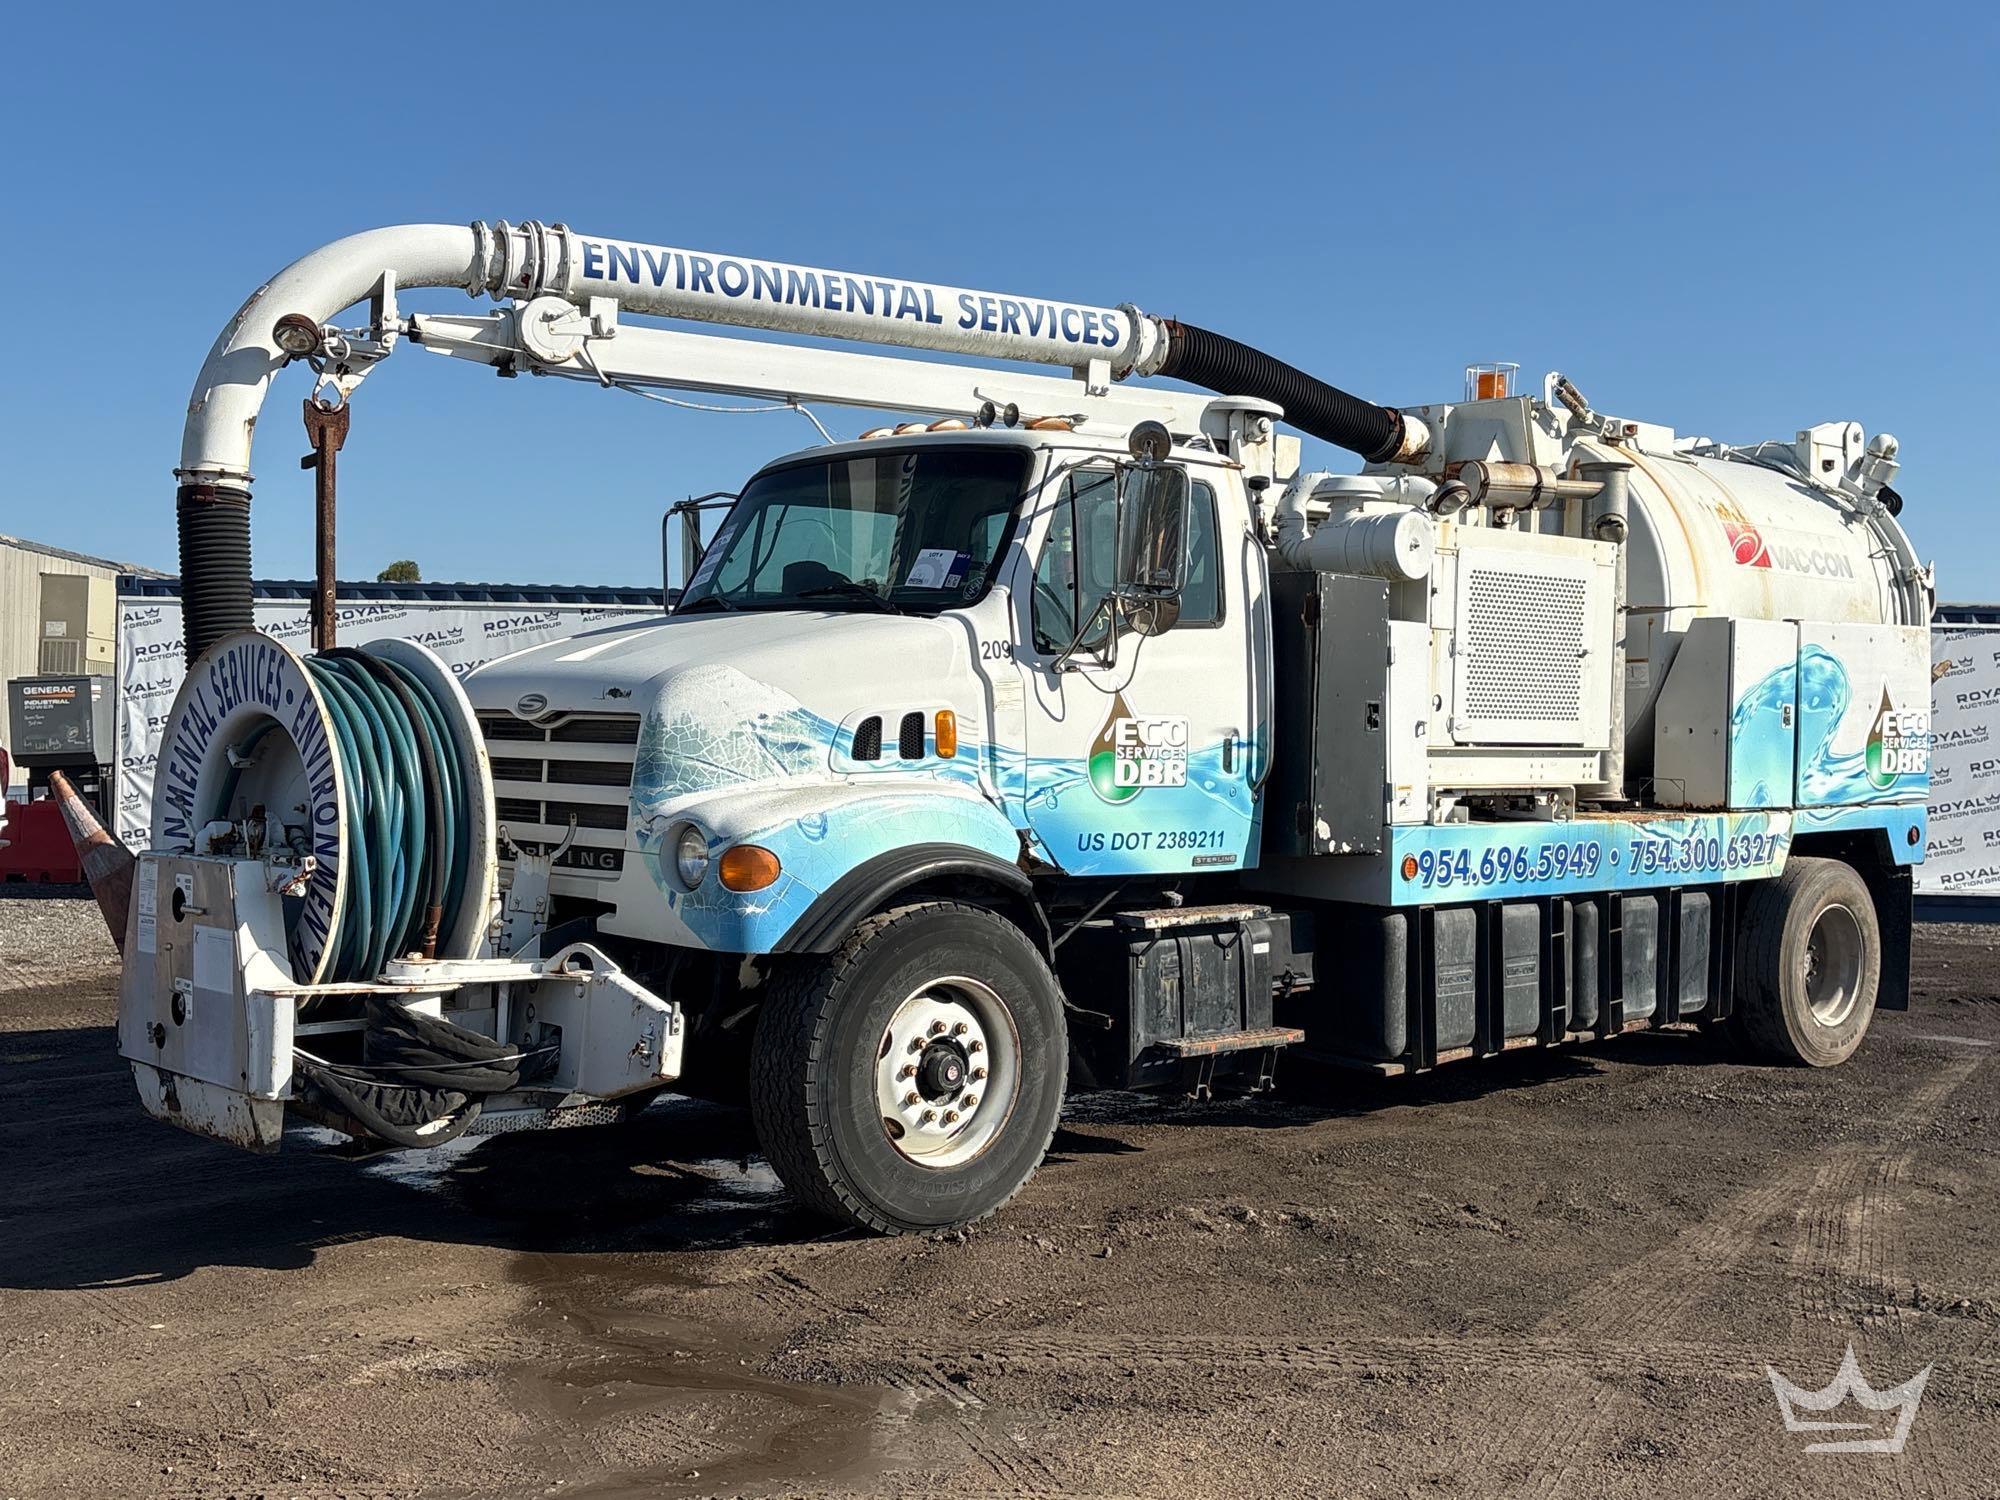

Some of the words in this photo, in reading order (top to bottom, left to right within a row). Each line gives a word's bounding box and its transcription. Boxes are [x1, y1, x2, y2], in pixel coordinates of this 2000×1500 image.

[583, 242, 943, 324] ENVIRONMENTAL
[956, 293, 1120, 348] SERVICES
[336, 617, 373, 629] UCTION
[374, 611, 407, 622] GROUP
[484, 614, 545, 632] ROYAL
[583, 611, 624, 622] AUCTION
[259, 620, 293, 633] YAL
[486, 627, 527, 639] AUCTION
[529, 621, 562, 632] GROUP
[277, 628, 310, 639] GROUP
[135, 640, 186, 656] ROYA
[432, 638, 465, 649] GROUP
[981, 640, 1010, 659] 209
[137, 652, 179, 663] AUCTION
[1944, 668, 1975, 677] GROUP
[209, 644, 286, 719] SERVICES
[23, 686, 76, 695] GENERAC
[123, 682, 157, 695] YAL
[141, 688, 174, 699] GROUP
[1959, 699, 1999, 710] AUCTION
[1883, 711, 1927, 737] ECO
[1117, 719, 1186, 747] ECO
[1930, 729, 1972, 744] OYAL
[1883, 737, 1927, 749] SERVICES
[1117, 747, 1186, 760] SERVICES
[122, 754, 158, 768] OYA
[1882, 749, 1927, 772] DBR
[1117, 760, 1186, 785] DBR
[1972, 770, 2000, 779] AUCTI
[1926, 798, 1986, 815] ROYAL
[1929, 811, 1970, 822] AUCTION
[1078, 833, 1105, 851] US
[1111, 832, 1152, 851] DOT
[1156, 830, 1225, 849] 2389211
[1195, 854, 1236, 864] STERLING
[1418, 841, 1601, 885] 954.696.5949
[1629, 832, 1779, 875] 754.300.6327
[1934, 847, 1965, 858] GROUP
[1940, 866, 1999, 884] ROYAL
[1943, 879, 1984, 891] AUCTION
